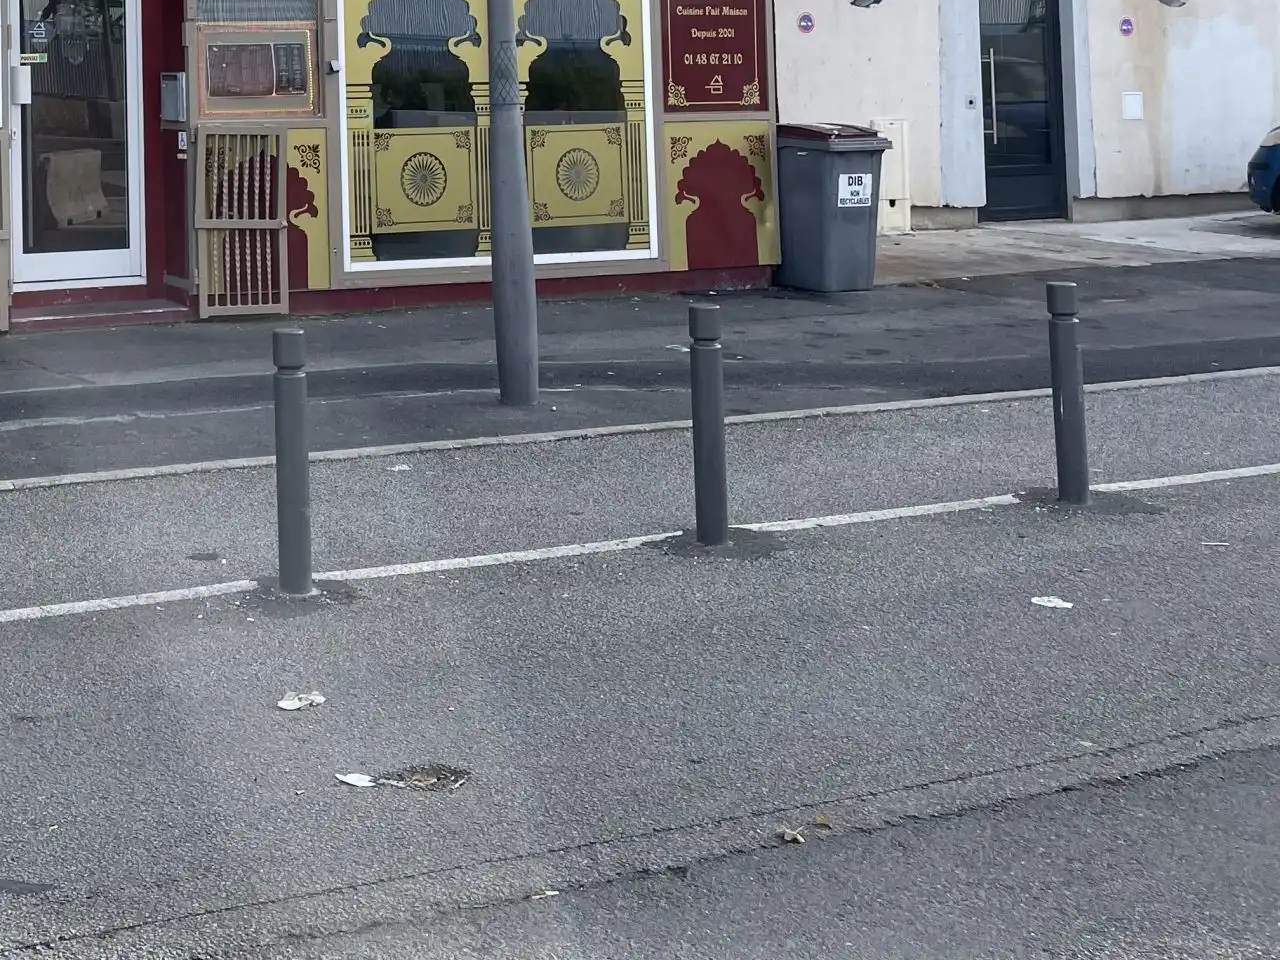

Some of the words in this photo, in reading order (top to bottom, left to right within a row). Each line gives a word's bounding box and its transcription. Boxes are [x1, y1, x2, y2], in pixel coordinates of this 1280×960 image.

[676, 5, 703, 16] Cuisine
[705, 5, 720, 16] Fait
[722, 6, 748, 16] Maison
[691, 28, 717, 39] Depuis
[718, 28, 735, 38] 2001
[684, 53, 693, 65] 01
[695, 53, 707, 65] 48
[709, 53, 720, 65] 67
[722, 53, 731, 65] 21
[734, 53, 743, 65] 10
[847, 175, 863, 186] DIB
